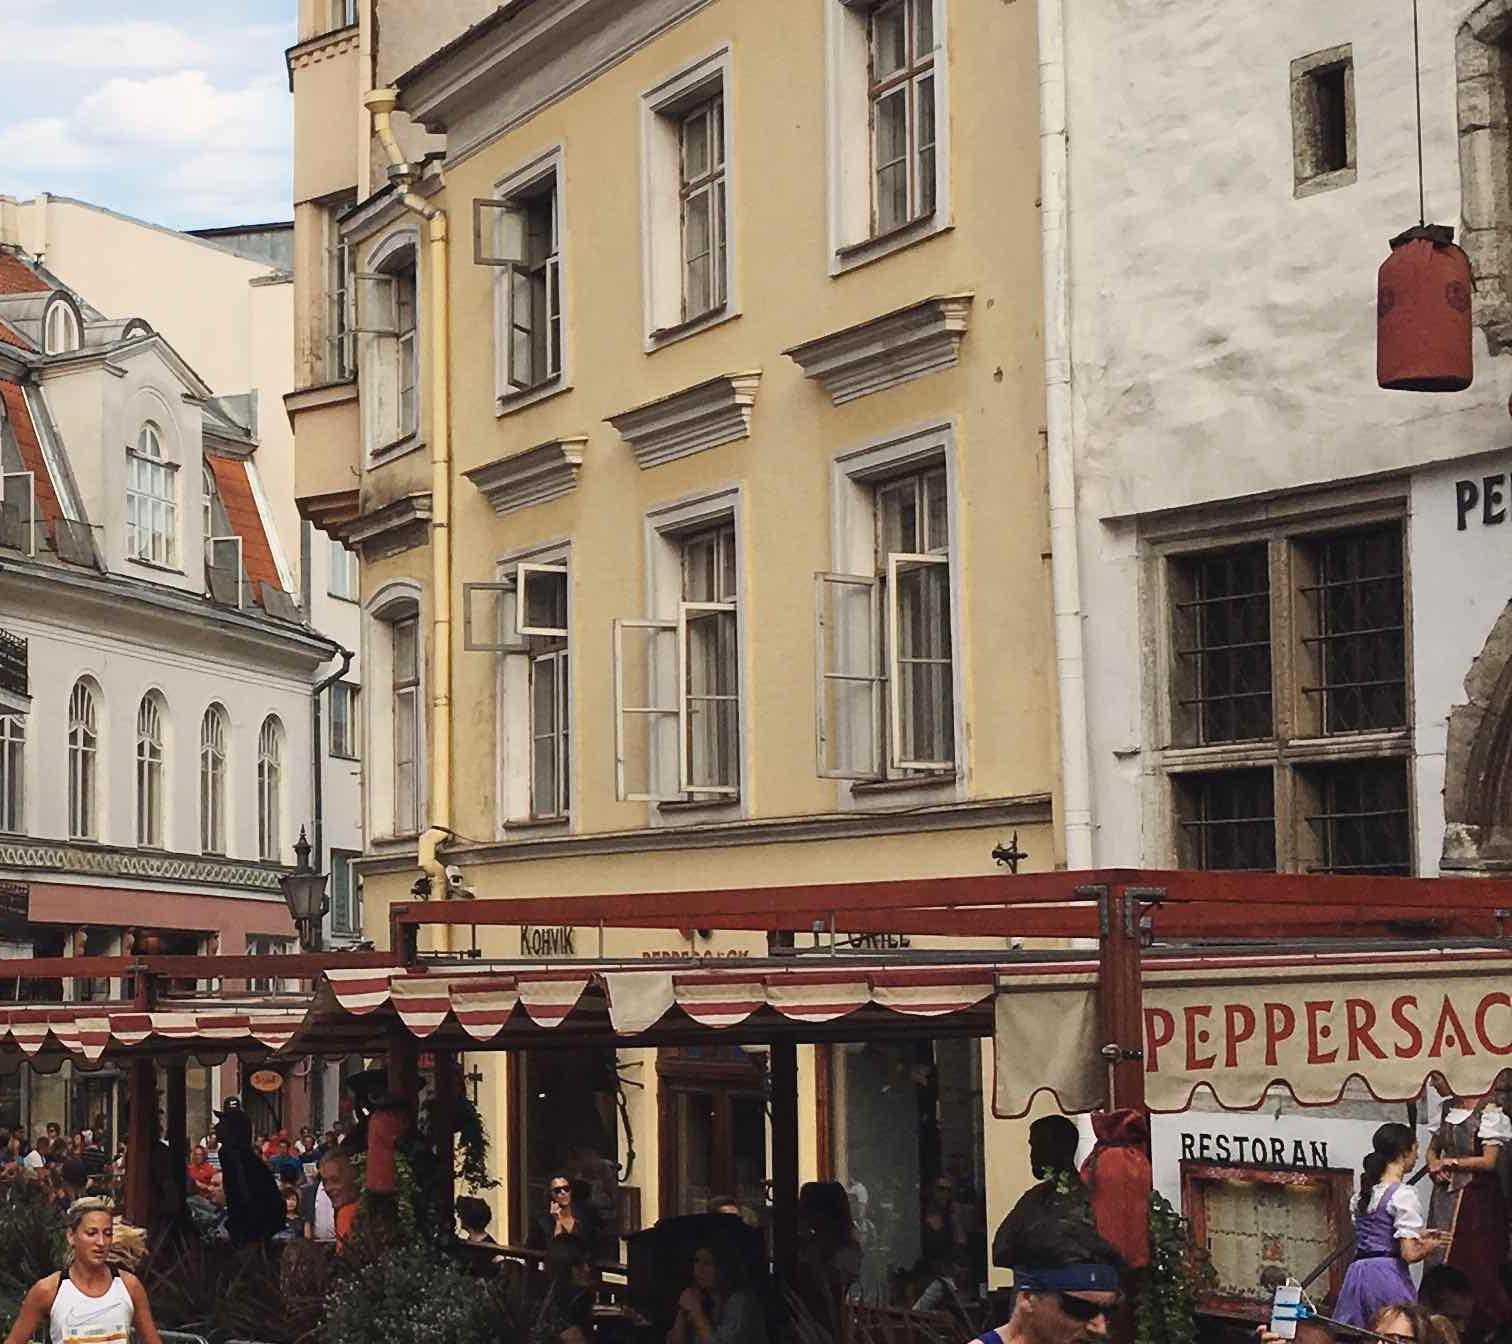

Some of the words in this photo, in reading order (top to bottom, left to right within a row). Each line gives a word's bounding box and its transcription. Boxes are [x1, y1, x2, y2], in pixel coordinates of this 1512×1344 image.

[1456, 473, 1512, 531] PE
[520, 925, 575, 955] KOHVIK
[1144, 992, 1512, 1073] PEPPERSAC
[1180, 1132, 1329, 1169] RESTORAN
